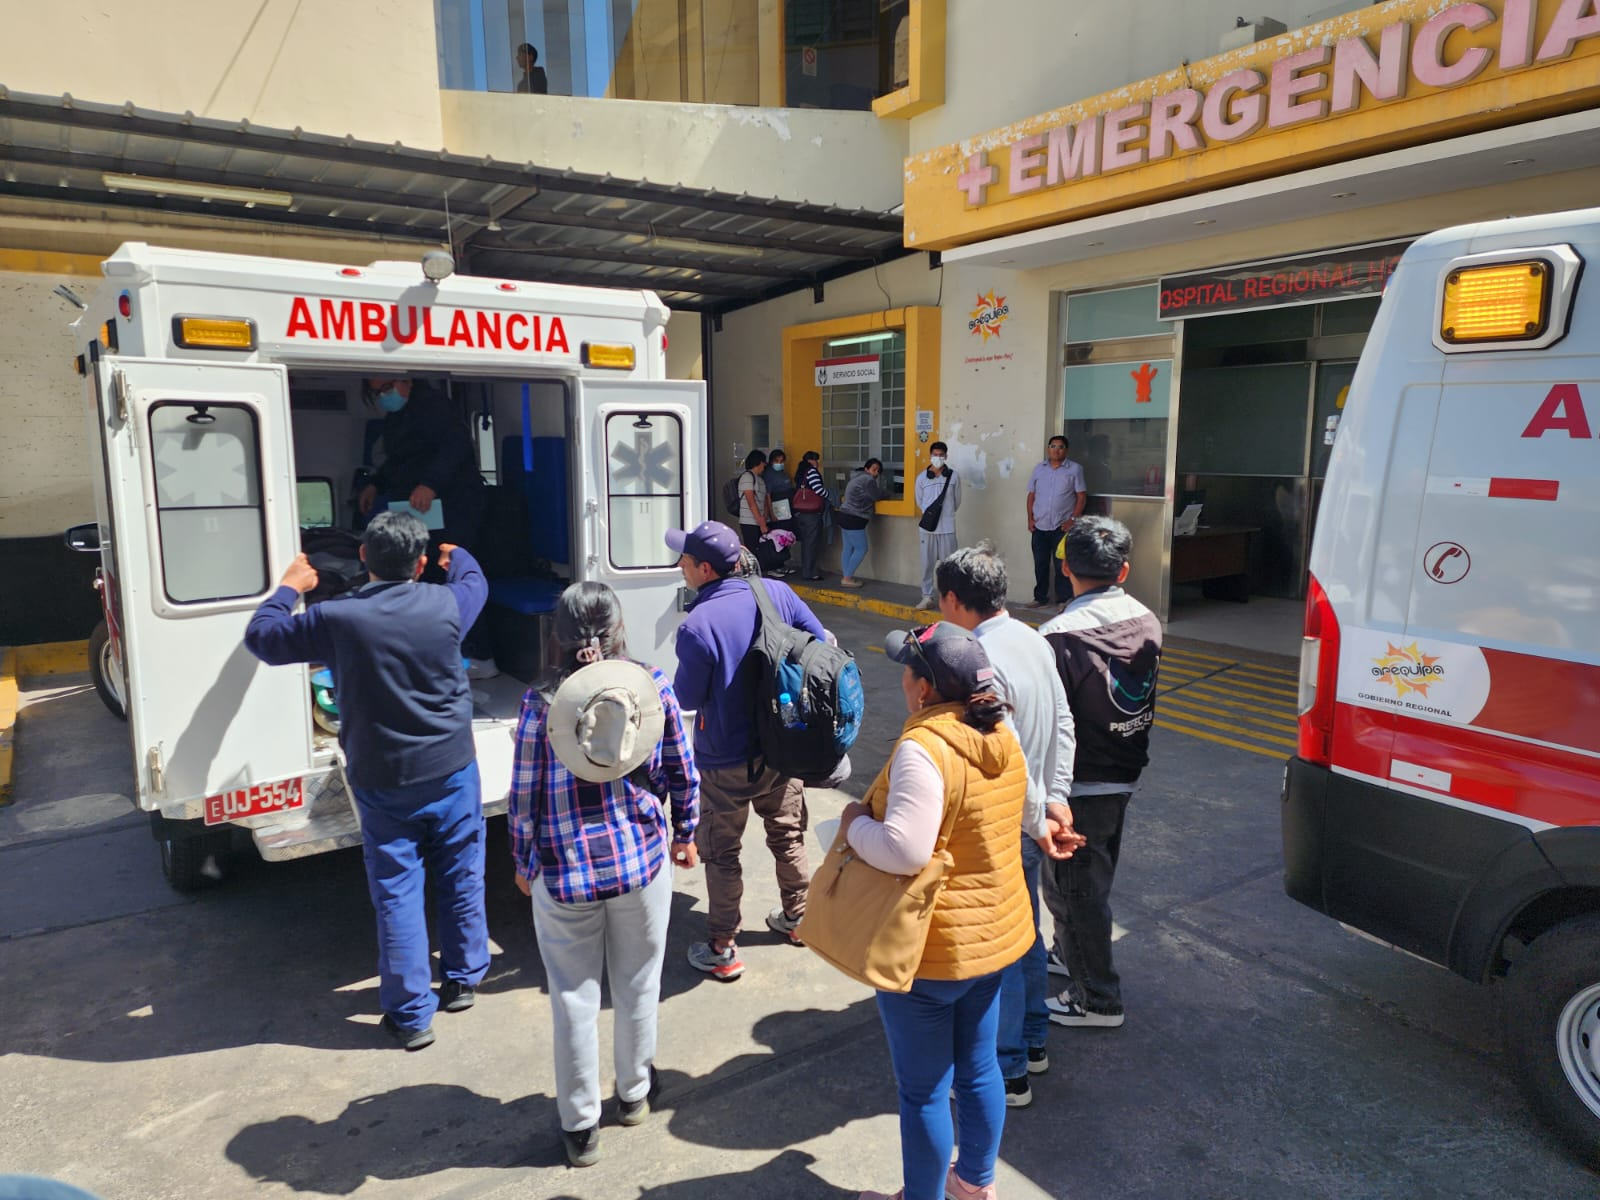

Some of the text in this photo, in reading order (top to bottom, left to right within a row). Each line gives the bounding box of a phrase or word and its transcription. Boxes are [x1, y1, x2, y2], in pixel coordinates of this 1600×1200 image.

[1009, 0, 1600, 195] EMERGENCIA
[1244, 265, 1359, 298] REGIONAL
[286, 297, 569, 353] AMBULANCIA
[832, 367, 876, 380] SERVICIO SOCIAL
[1520, 383, 1600, 440] A
[1358, 693, 1452, 717] GOBIERNO REGIONAL
